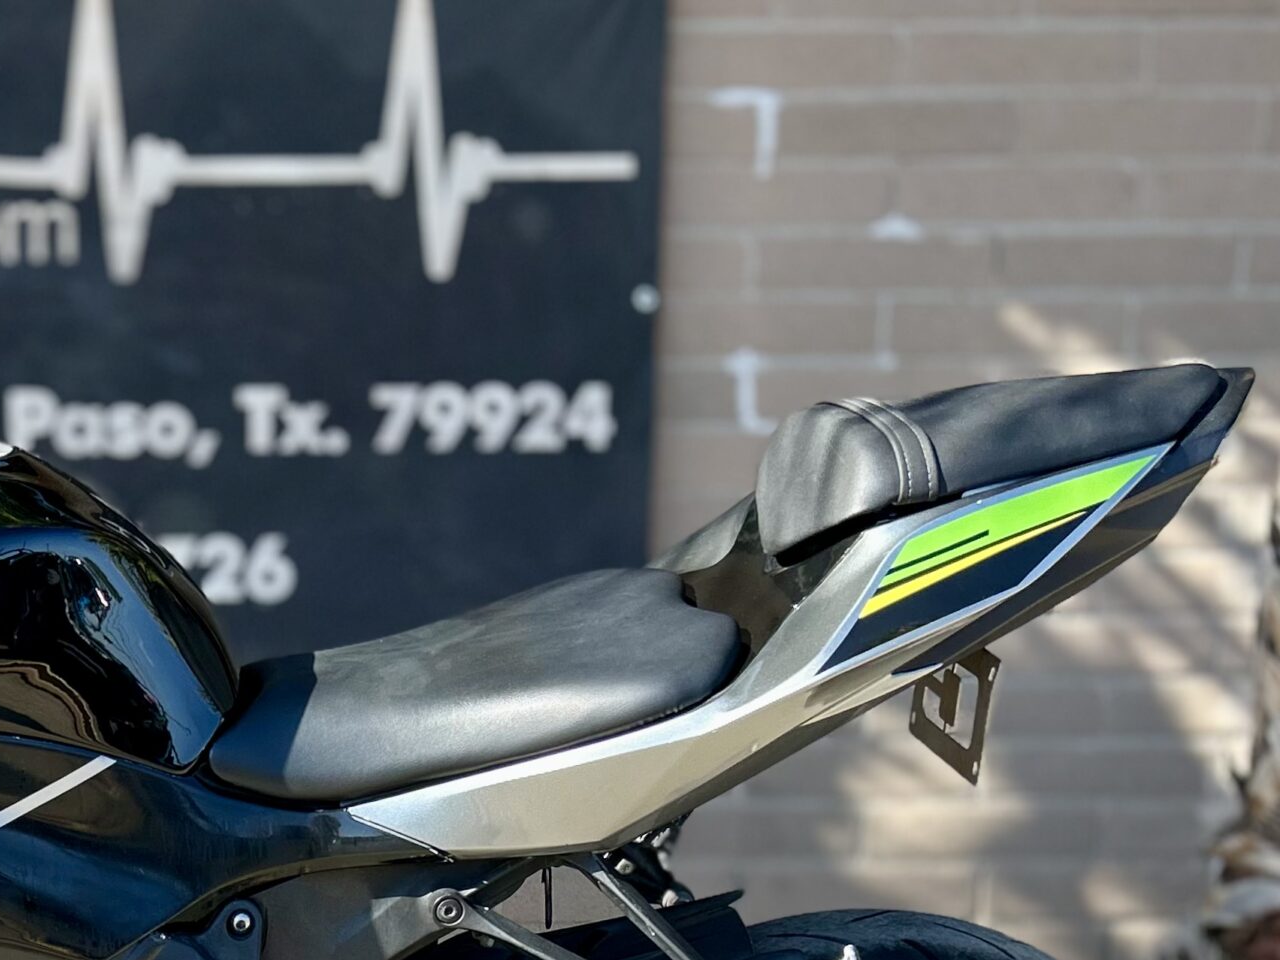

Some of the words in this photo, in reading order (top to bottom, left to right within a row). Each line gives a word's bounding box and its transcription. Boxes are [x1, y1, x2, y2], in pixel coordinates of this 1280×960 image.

[1, 384, 219, 469] Paso,
[233, 383, 349, 455] Tx.
[369, 381, 616, 453] 79924
